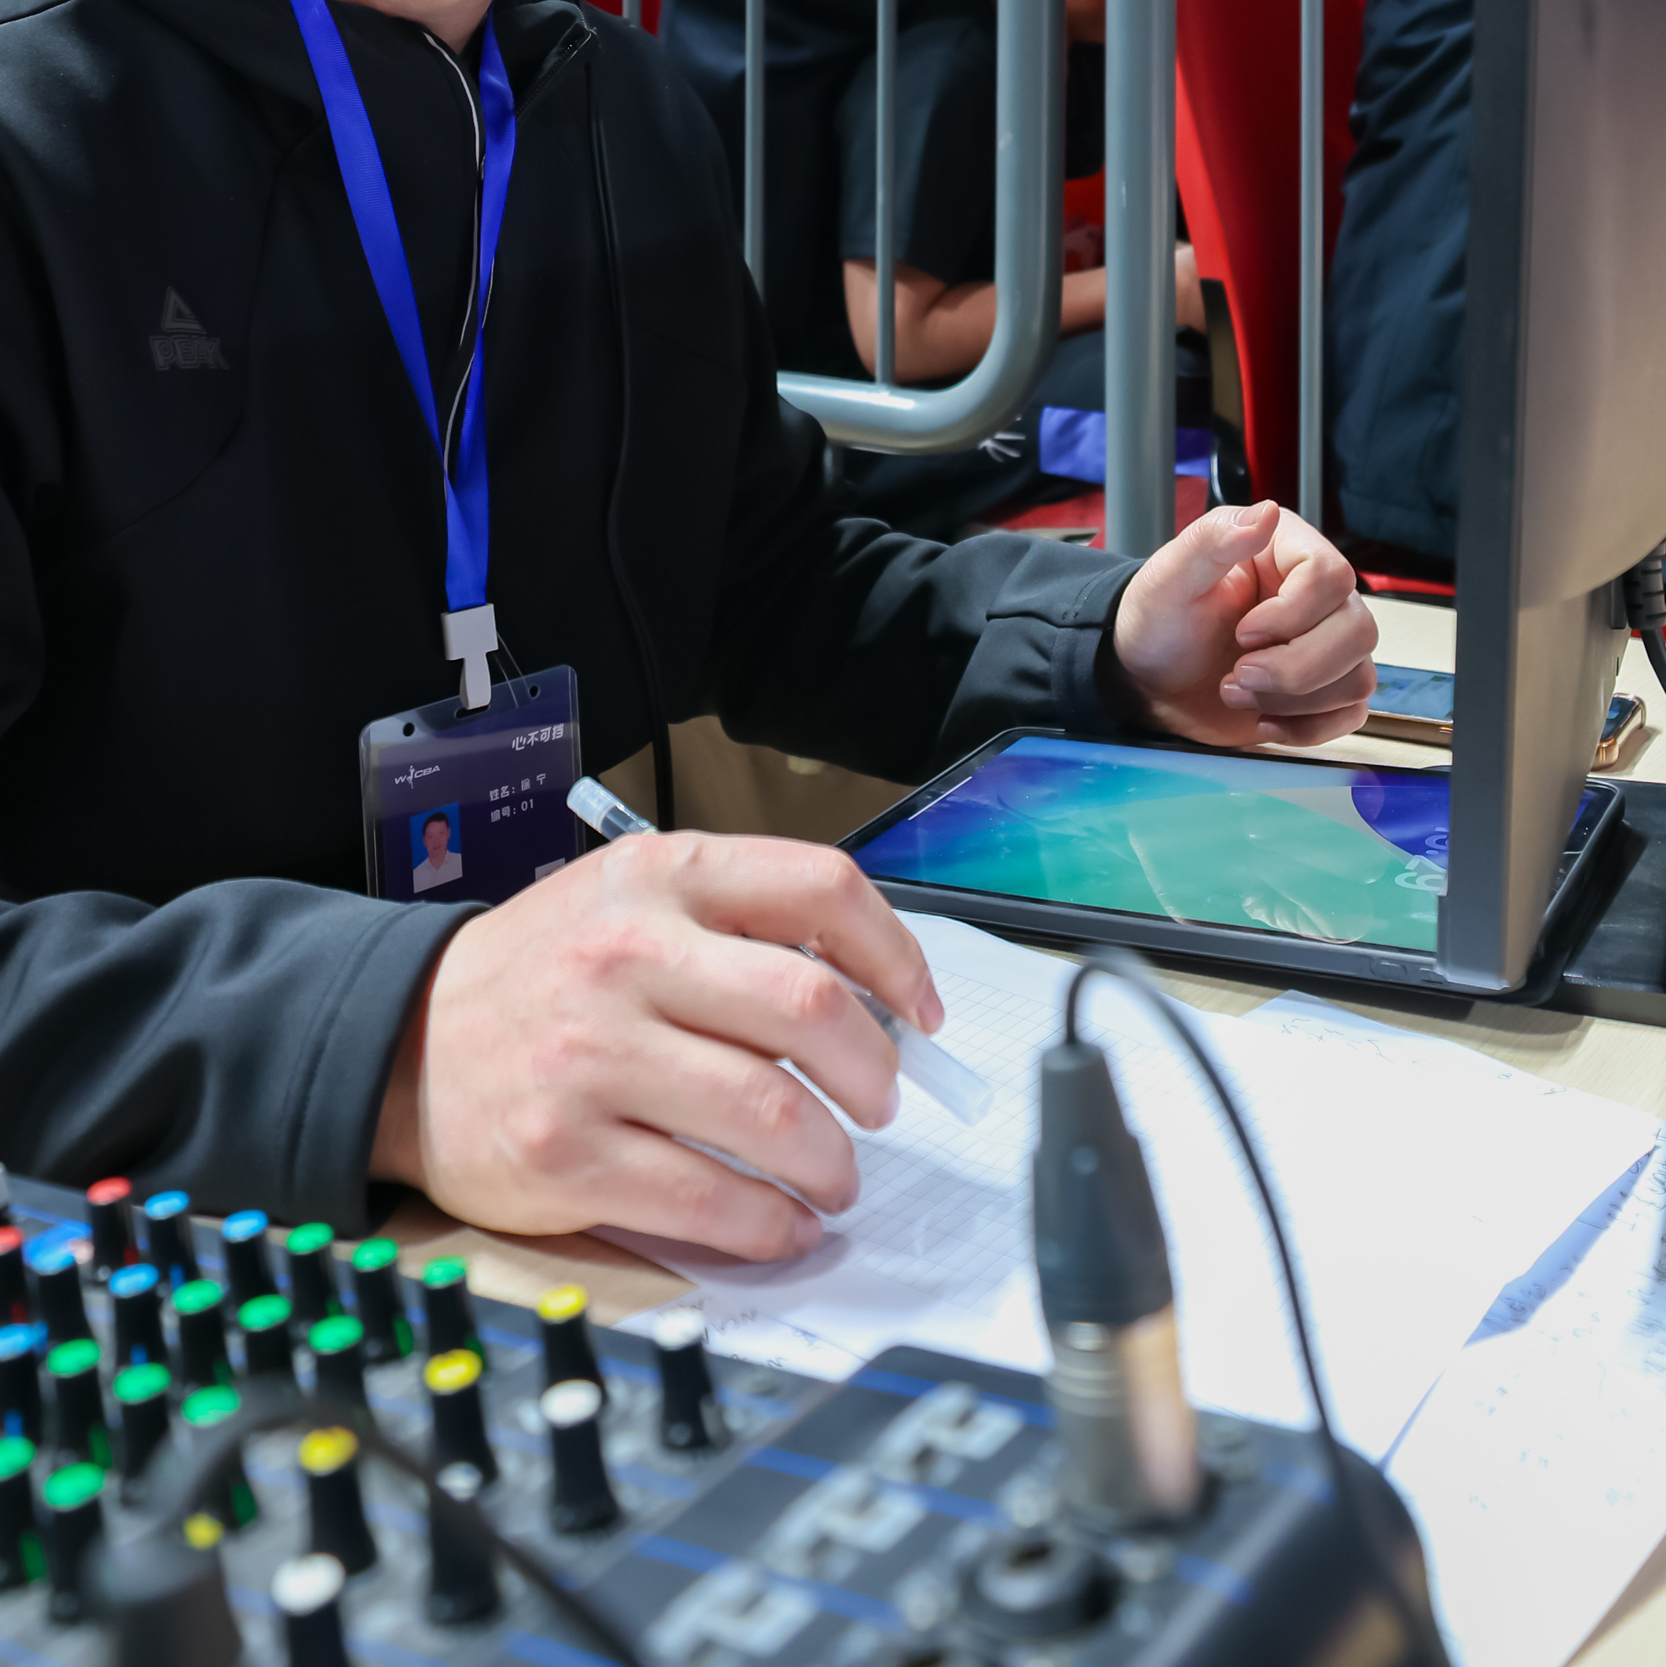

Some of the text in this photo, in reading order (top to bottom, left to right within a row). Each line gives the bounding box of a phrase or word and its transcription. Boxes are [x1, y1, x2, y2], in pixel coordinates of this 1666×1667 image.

[149, 334, 231, 371] PEAK
[511, 722, 565, 752] 心不可挡
